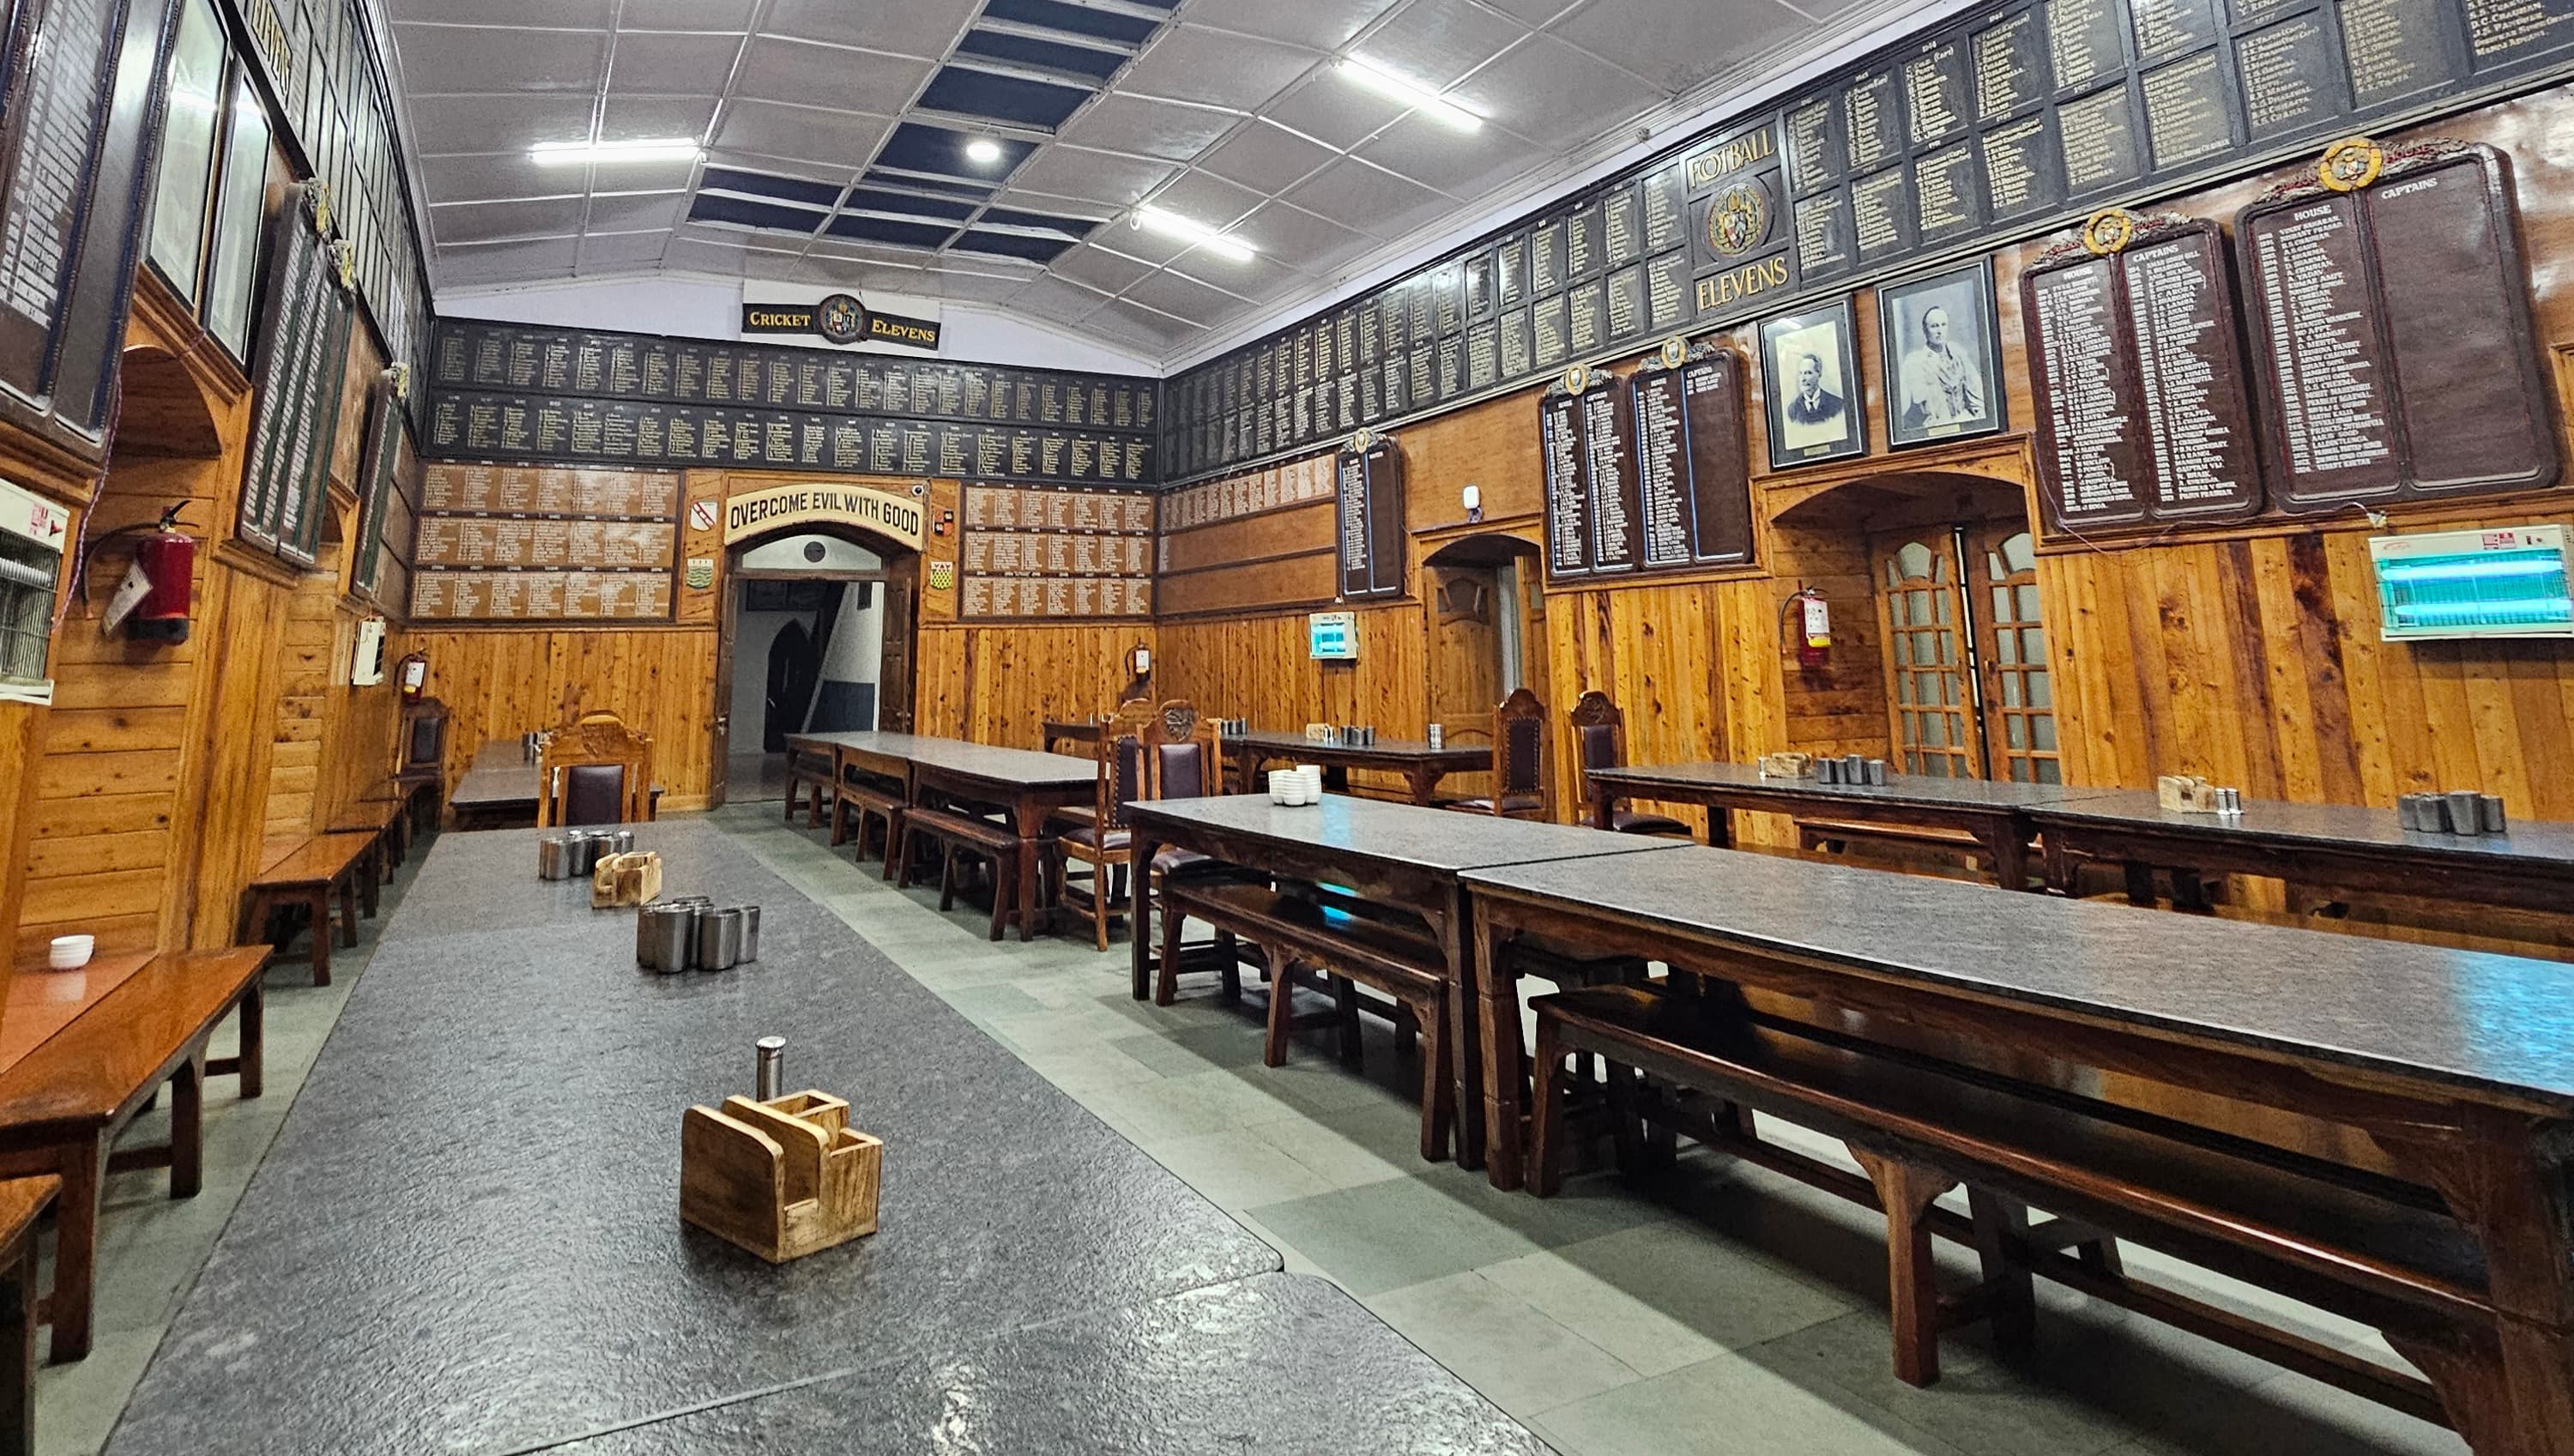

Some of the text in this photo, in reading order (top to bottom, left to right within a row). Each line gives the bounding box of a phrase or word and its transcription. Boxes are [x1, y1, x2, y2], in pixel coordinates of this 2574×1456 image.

[2294, 178, 2438, 221] HOUSE CAPTAINS
[1696, 256, 1789, 311] ELEVENS
[2063, 245, 2178, 281] HOUSE CAPTAINS
[749, 311, 936, 342] CRICKET ELEVENS
[730, 492, 919, 536] OVERCOME EVIL WITH GOOD
